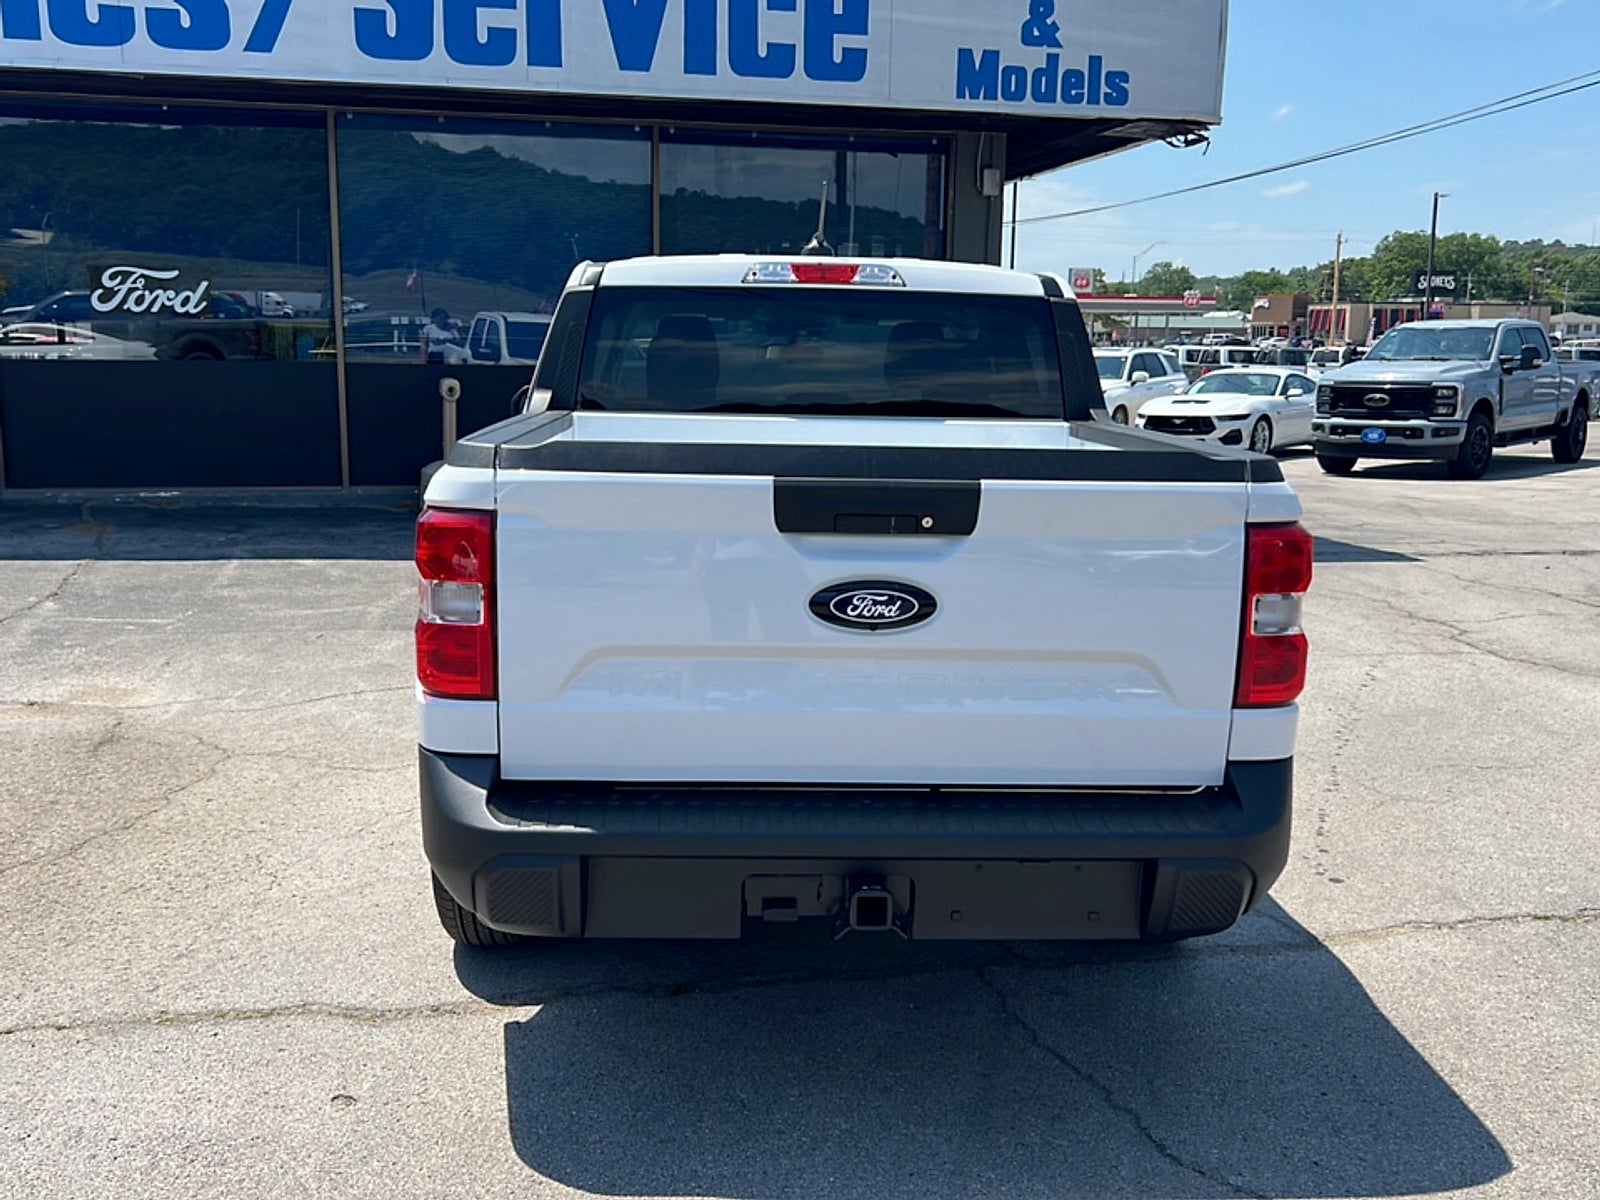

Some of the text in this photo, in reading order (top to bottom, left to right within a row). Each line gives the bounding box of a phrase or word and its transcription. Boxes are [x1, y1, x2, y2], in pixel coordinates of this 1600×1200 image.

[1021, 0, 1064, 48] &
[956, 47, 1130, 106] Models
[90, 266, 209, 314] Ford
[846, 593, 903, 617] Ford
